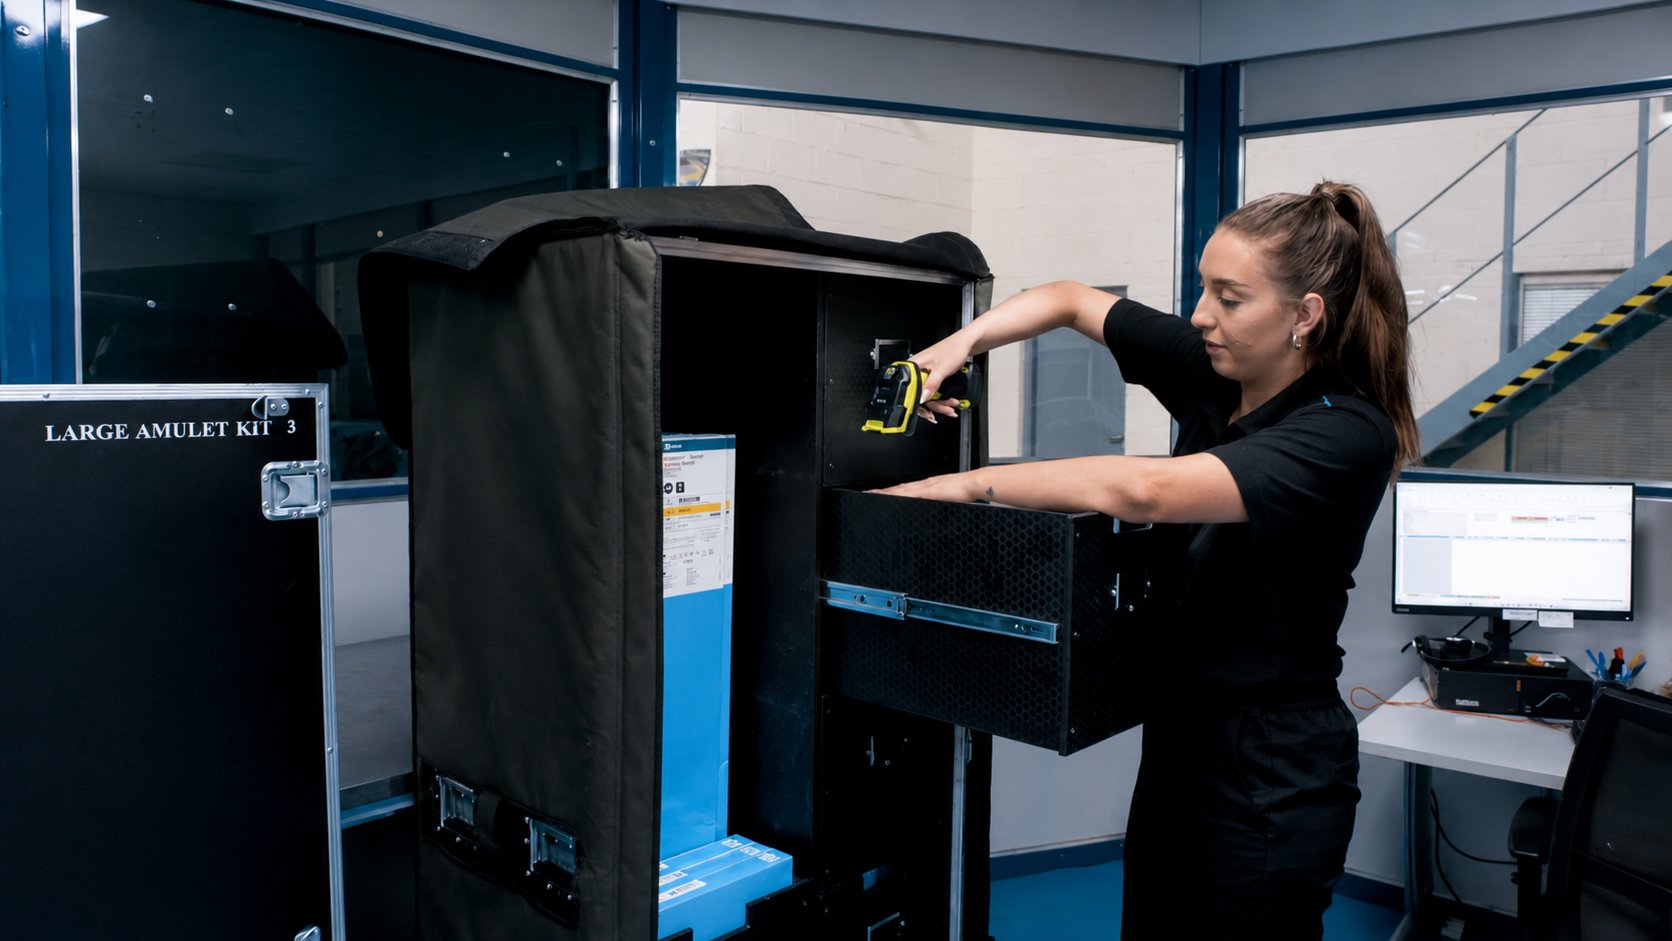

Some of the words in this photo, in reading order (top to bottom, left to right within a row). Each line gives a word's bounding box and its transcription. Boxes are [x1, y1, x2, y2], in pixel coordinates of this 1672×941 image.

[45, 424, 129, 442] LARGE
[135, 421, 229, 440] AMULET
[236, 420, 272, 436] KIT
[287, 420, 296, 434] 3
